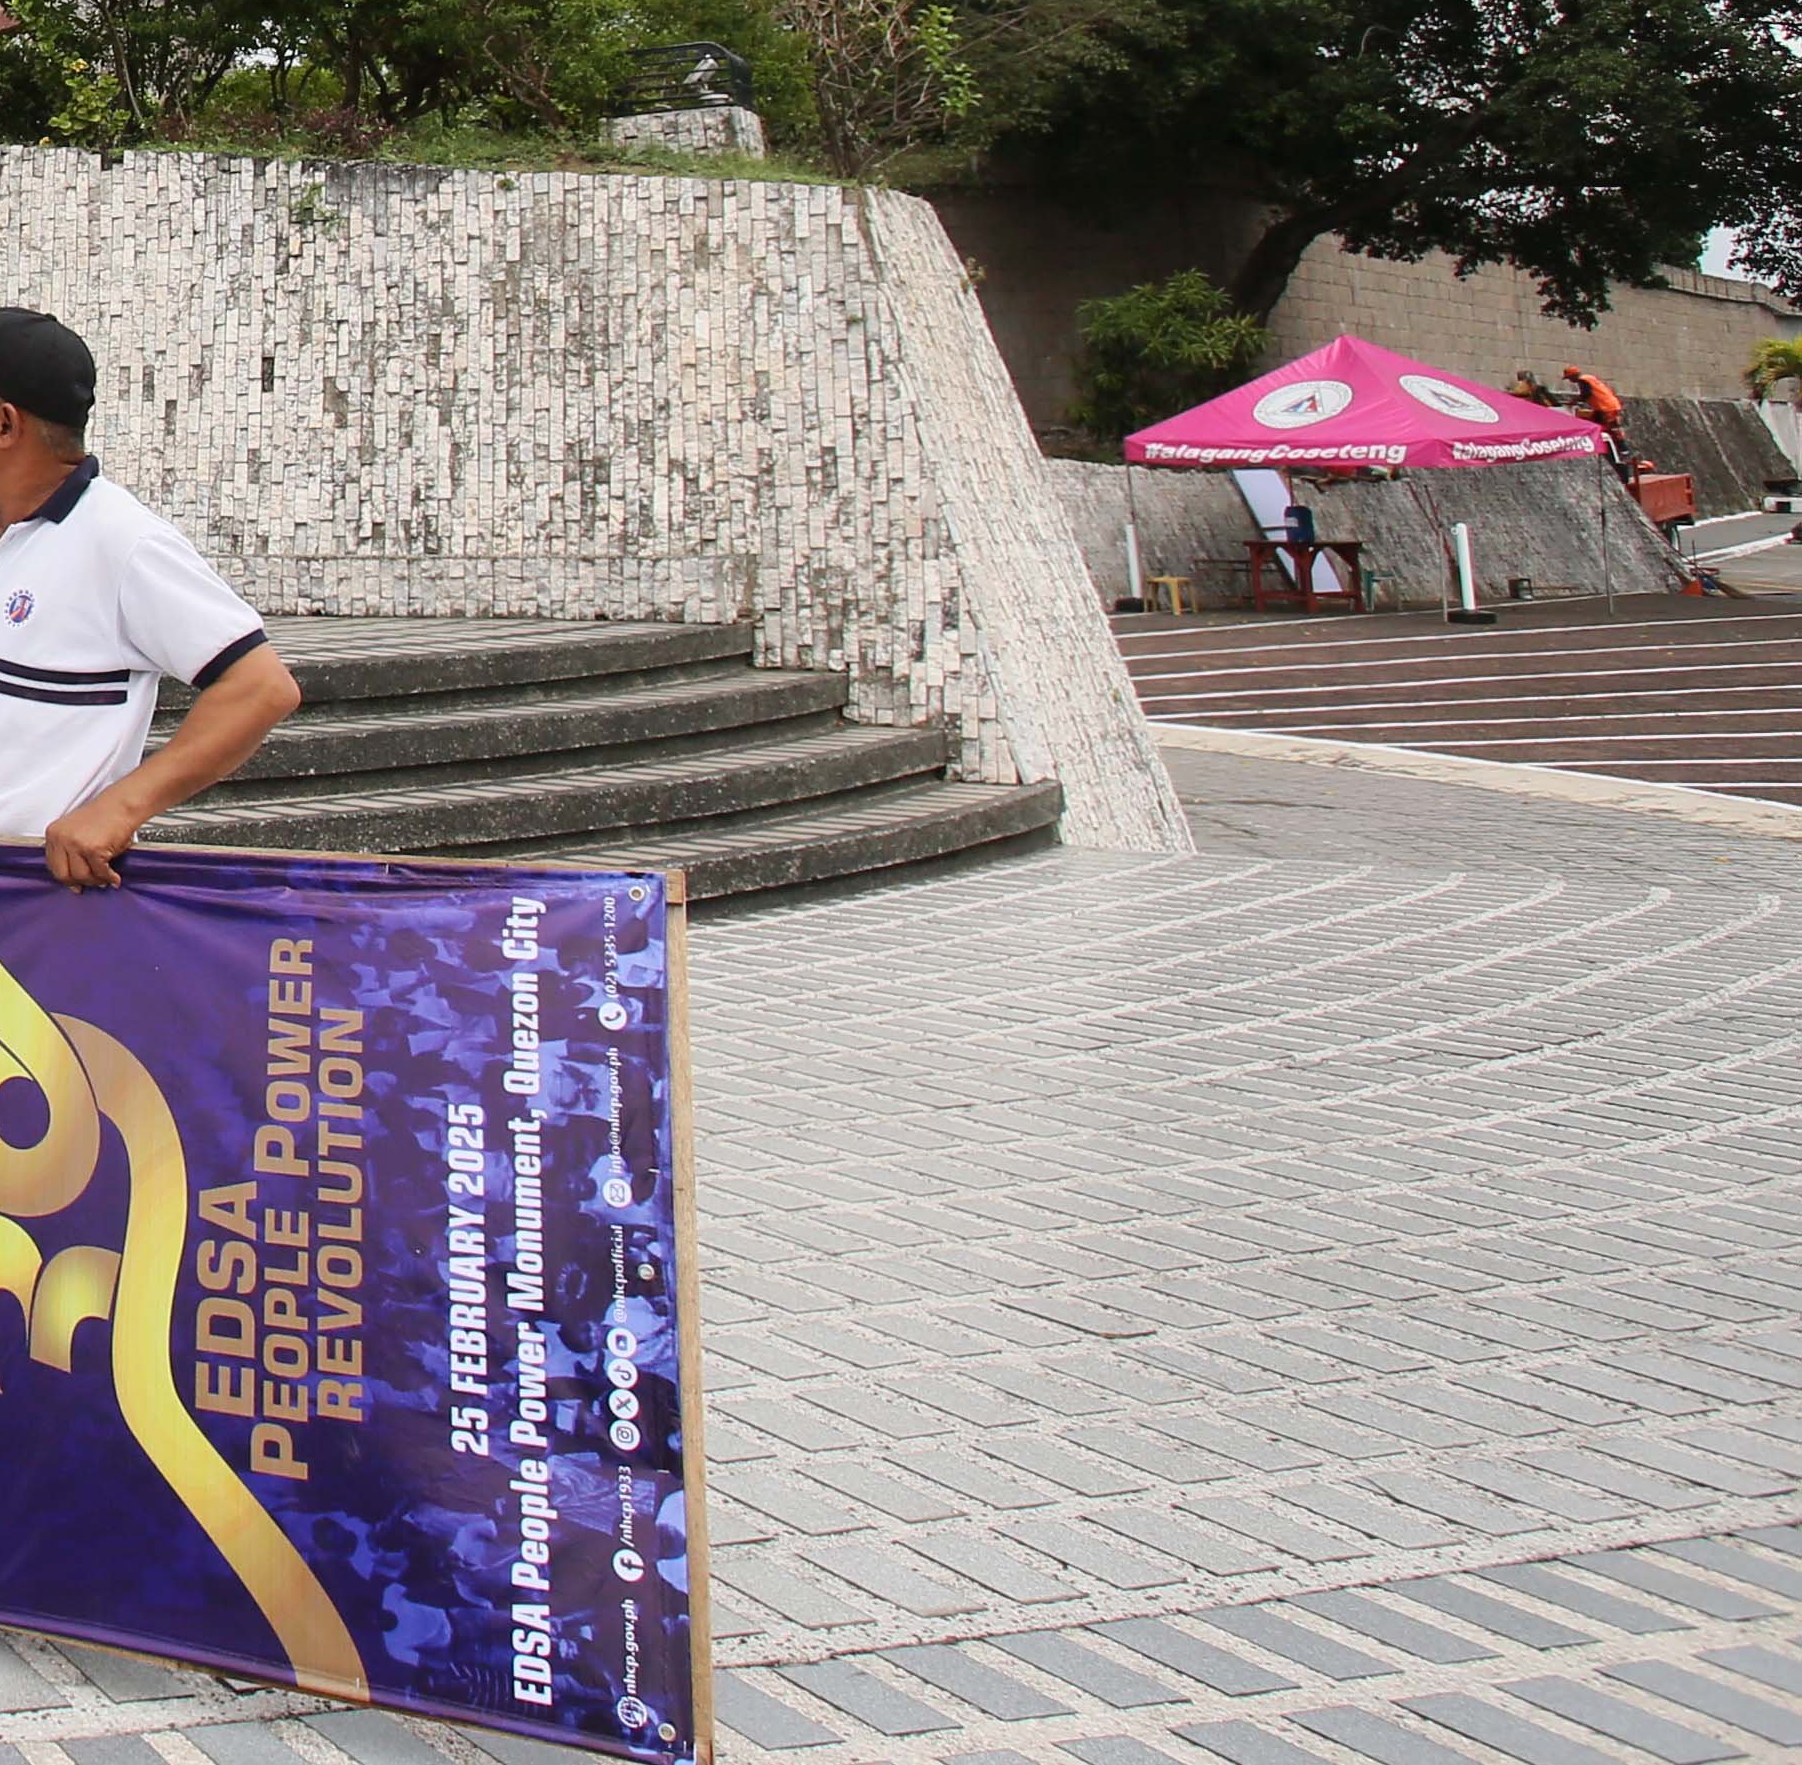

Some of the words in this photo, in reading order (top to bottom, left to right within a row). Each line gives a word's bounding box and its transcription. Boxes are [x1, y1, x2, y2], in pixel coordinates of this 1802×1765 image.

[501, 896, 545, 961] City
[603, 896, 617, 967] 5335-1200
[603, 971, 618, 999] (02)
[254, 938, 313, 1177] POWER
[503, 973, 540, 1095] Quezon
[448, 1104, 485, 1195] 2025
[605, 1048, 623, 1174] info@nhcp.gov.ph
[317, 1007, 363, 1423] REVOLUTION
[506, 1109, 547, 1312] Monument,
[195, 1180, 258, 1418] EDSA
[250, 1208, 309, 1480] PEOPLE
[448, 1205, 488, 1395] FEBRUARY
[451, 1406, 489, 1456] 25
[509, 1323, 548, 1447] Power
[510, 1459, 558, 1591] People
[511, 1604, 552, 1705] EDSA
[620, 1599, 638, 1694] nhcp.gov.ph
